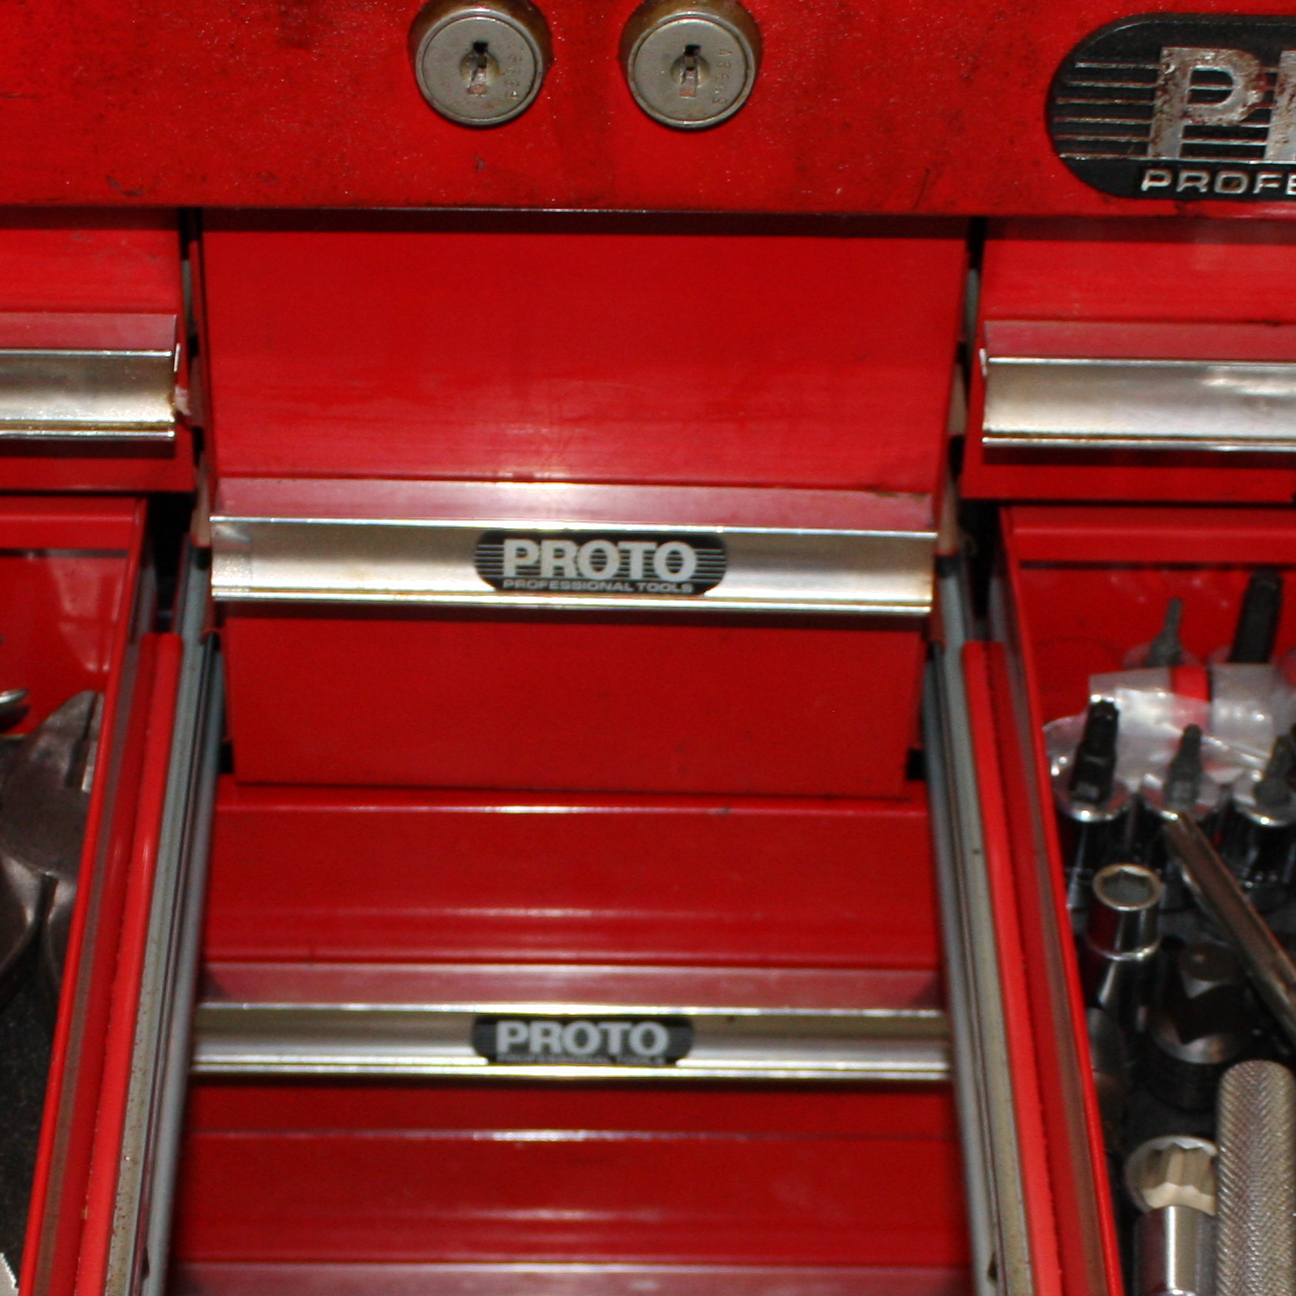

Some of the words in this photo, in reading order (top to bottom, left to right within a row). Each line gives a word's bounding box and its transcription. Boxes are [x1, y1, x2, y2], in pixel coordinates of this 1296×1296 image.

[503, 538, 697, 582] PROTO
[503, 578, 632, 593] PROFESSIONAL
[636, 580, 694, 594] TOOLS
[496, 1020, 669, 1057] PROTO
